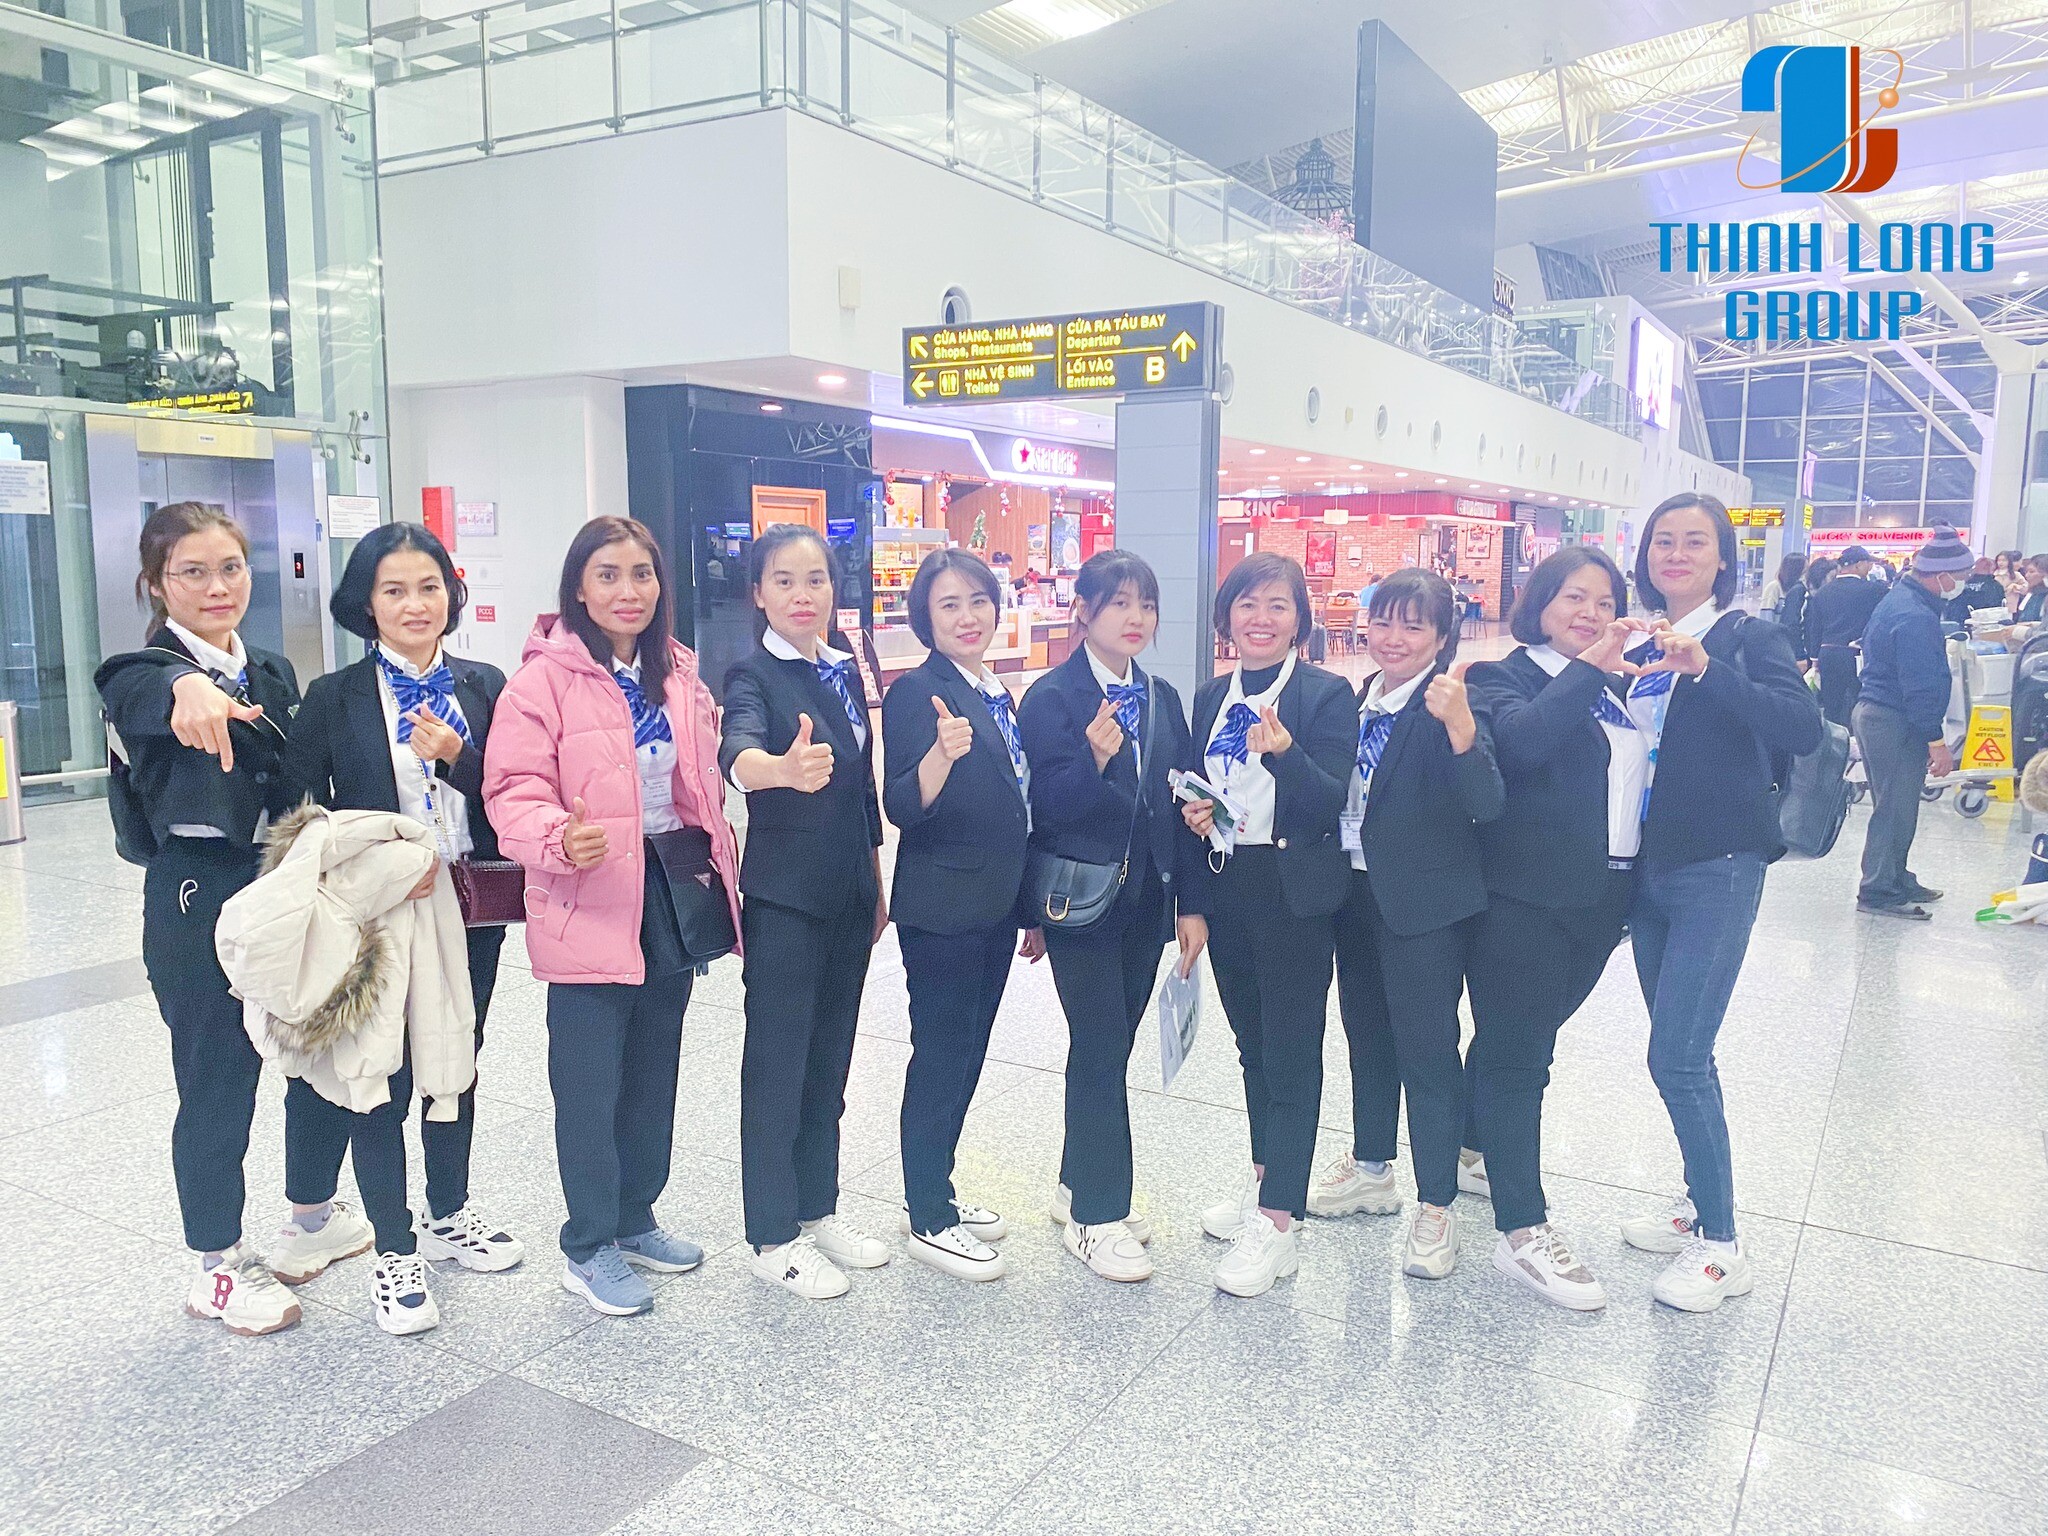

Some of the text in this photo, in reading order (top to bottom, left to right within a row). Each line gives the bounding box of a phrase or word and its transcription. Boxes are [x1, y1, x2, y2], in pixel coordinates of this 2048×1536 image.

[1094, 319, 1112, 332] RA
[1140, 313, 1166, 328] BAY
[958, 328, 993, 344] HÀNG,
[995, 324, 1018, 340] NHÀ
[1021, 322, 1054, 338] HÀNG
[971, 340, 1033, 357] Restaurants
[1066, 335, 1121, 351] Departure
[964, 365, 987, 381] NHÀ
[1007, 364, 1035, 379] SINH
[1088, 357, 1114, 373] VÀO
[1146, 356, 1165, 382] B
[964, 381, 1000, 395] Toilets
[1066, 375, 1116, 388] Entrance
